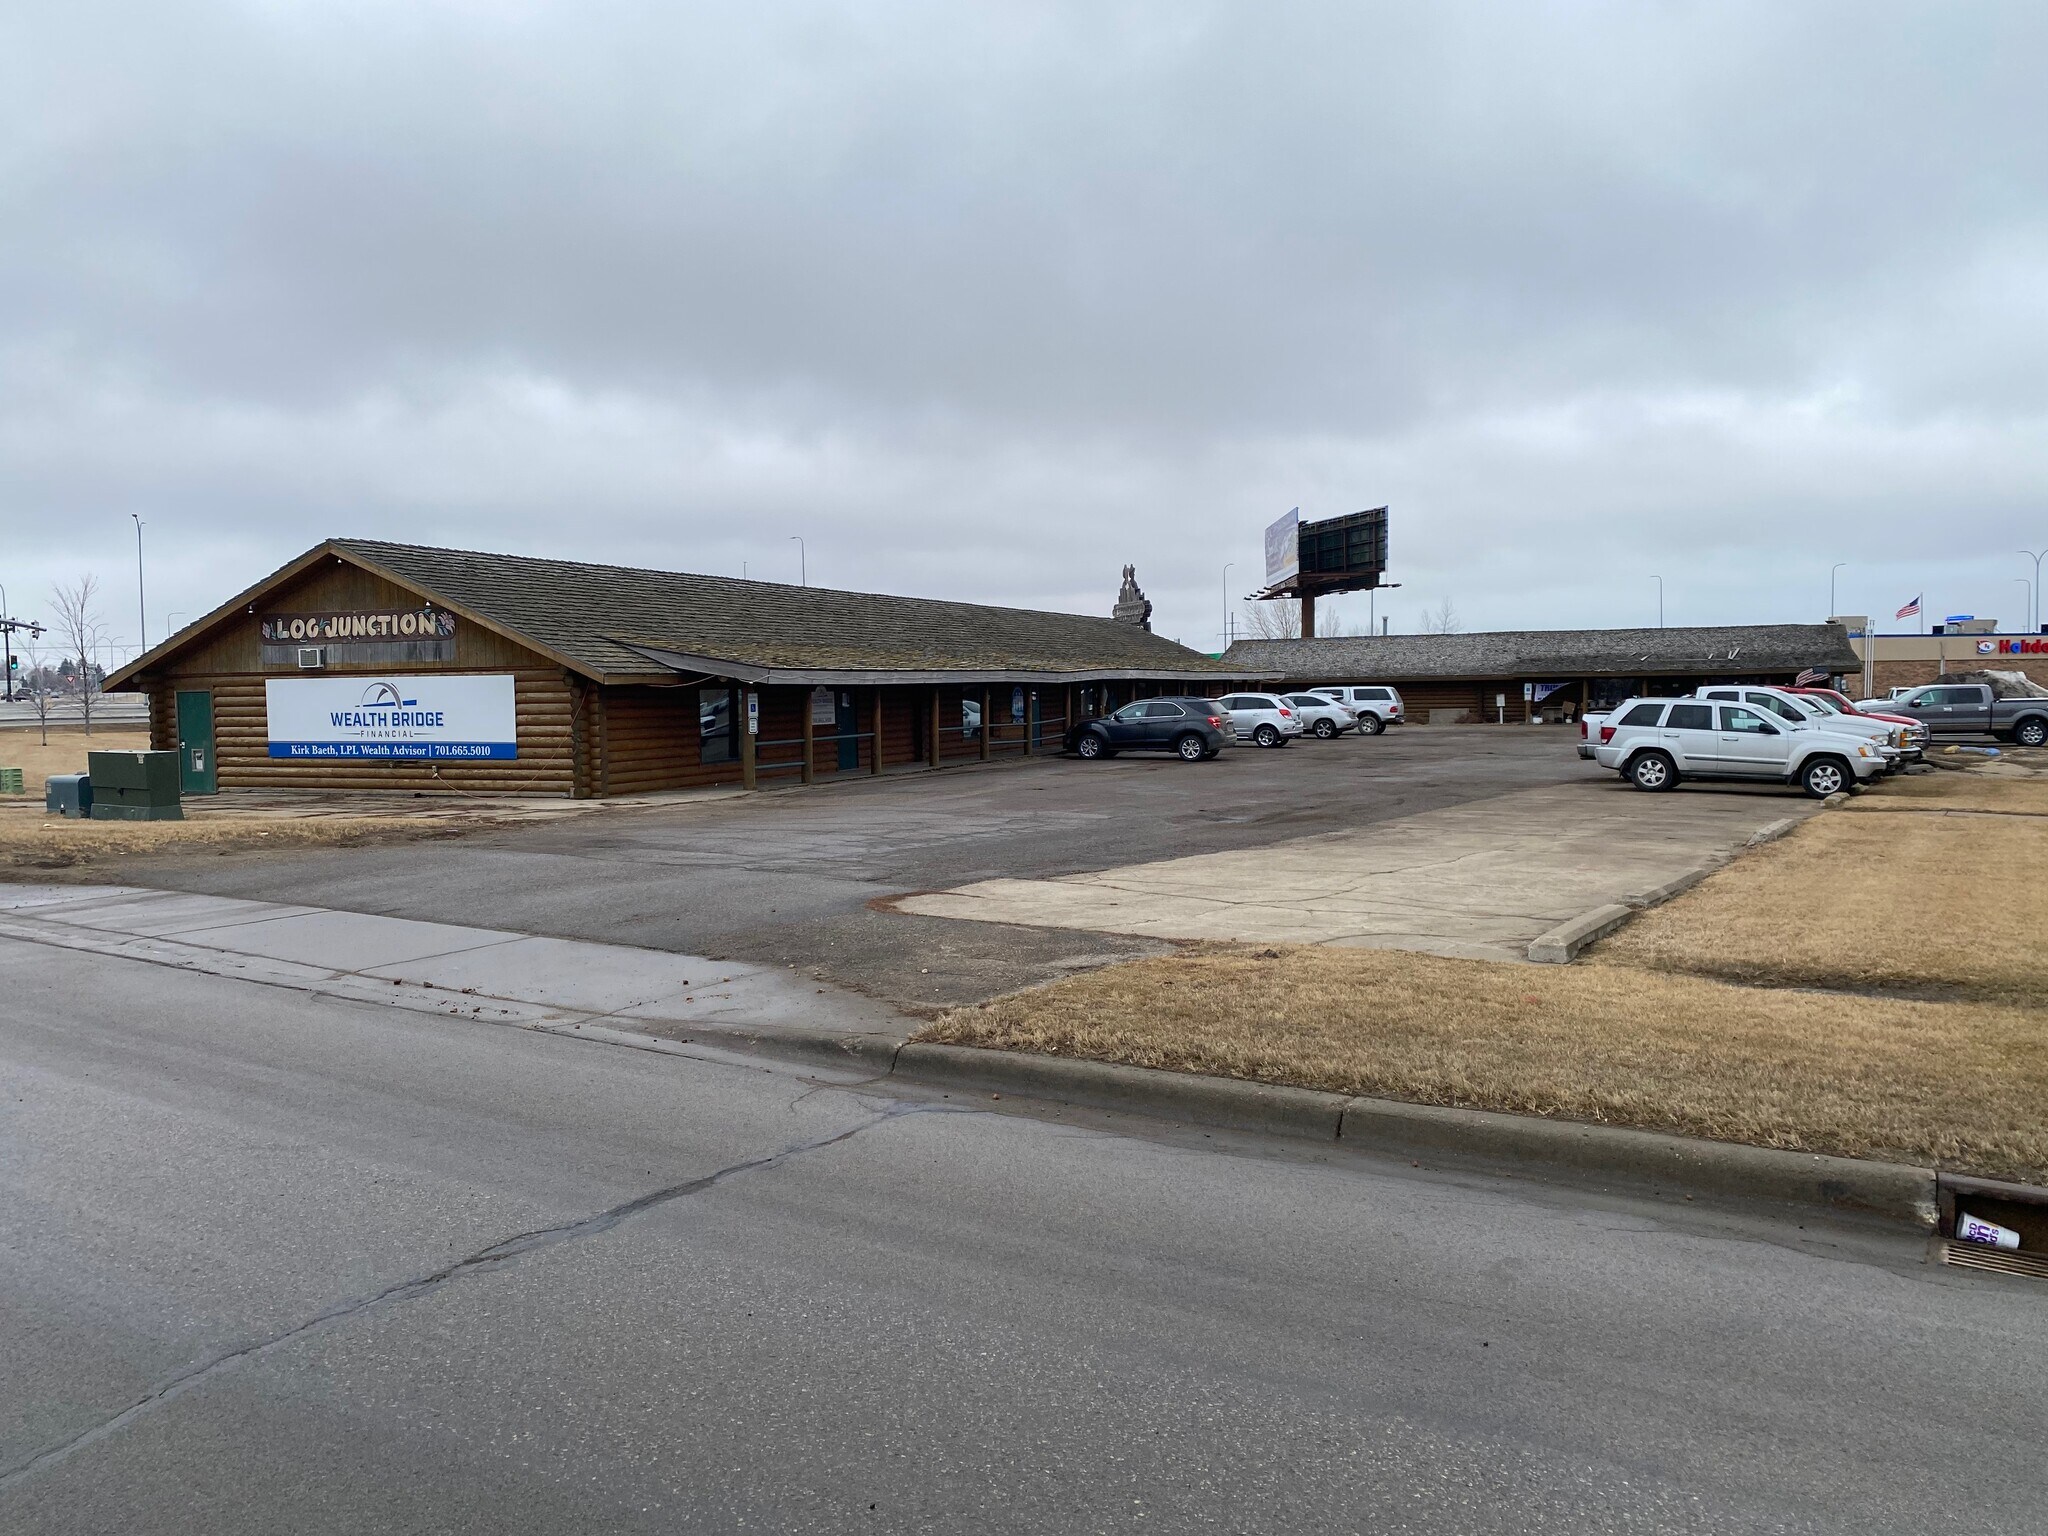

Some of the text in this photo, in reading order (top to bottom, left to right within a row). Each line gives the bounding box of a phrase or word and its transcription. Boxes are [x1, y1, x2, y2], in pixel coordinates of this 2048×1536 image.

[277, 612, 436, 639] LOG JUNCTION
[330, 712, 444, 727] WEALTH BRIDGE
[360, 730, 414, 738] FINANCIAL
[291, 745, 491, 756] Kirk Baeth, LPL Wealth Advisor 701.665.5010
